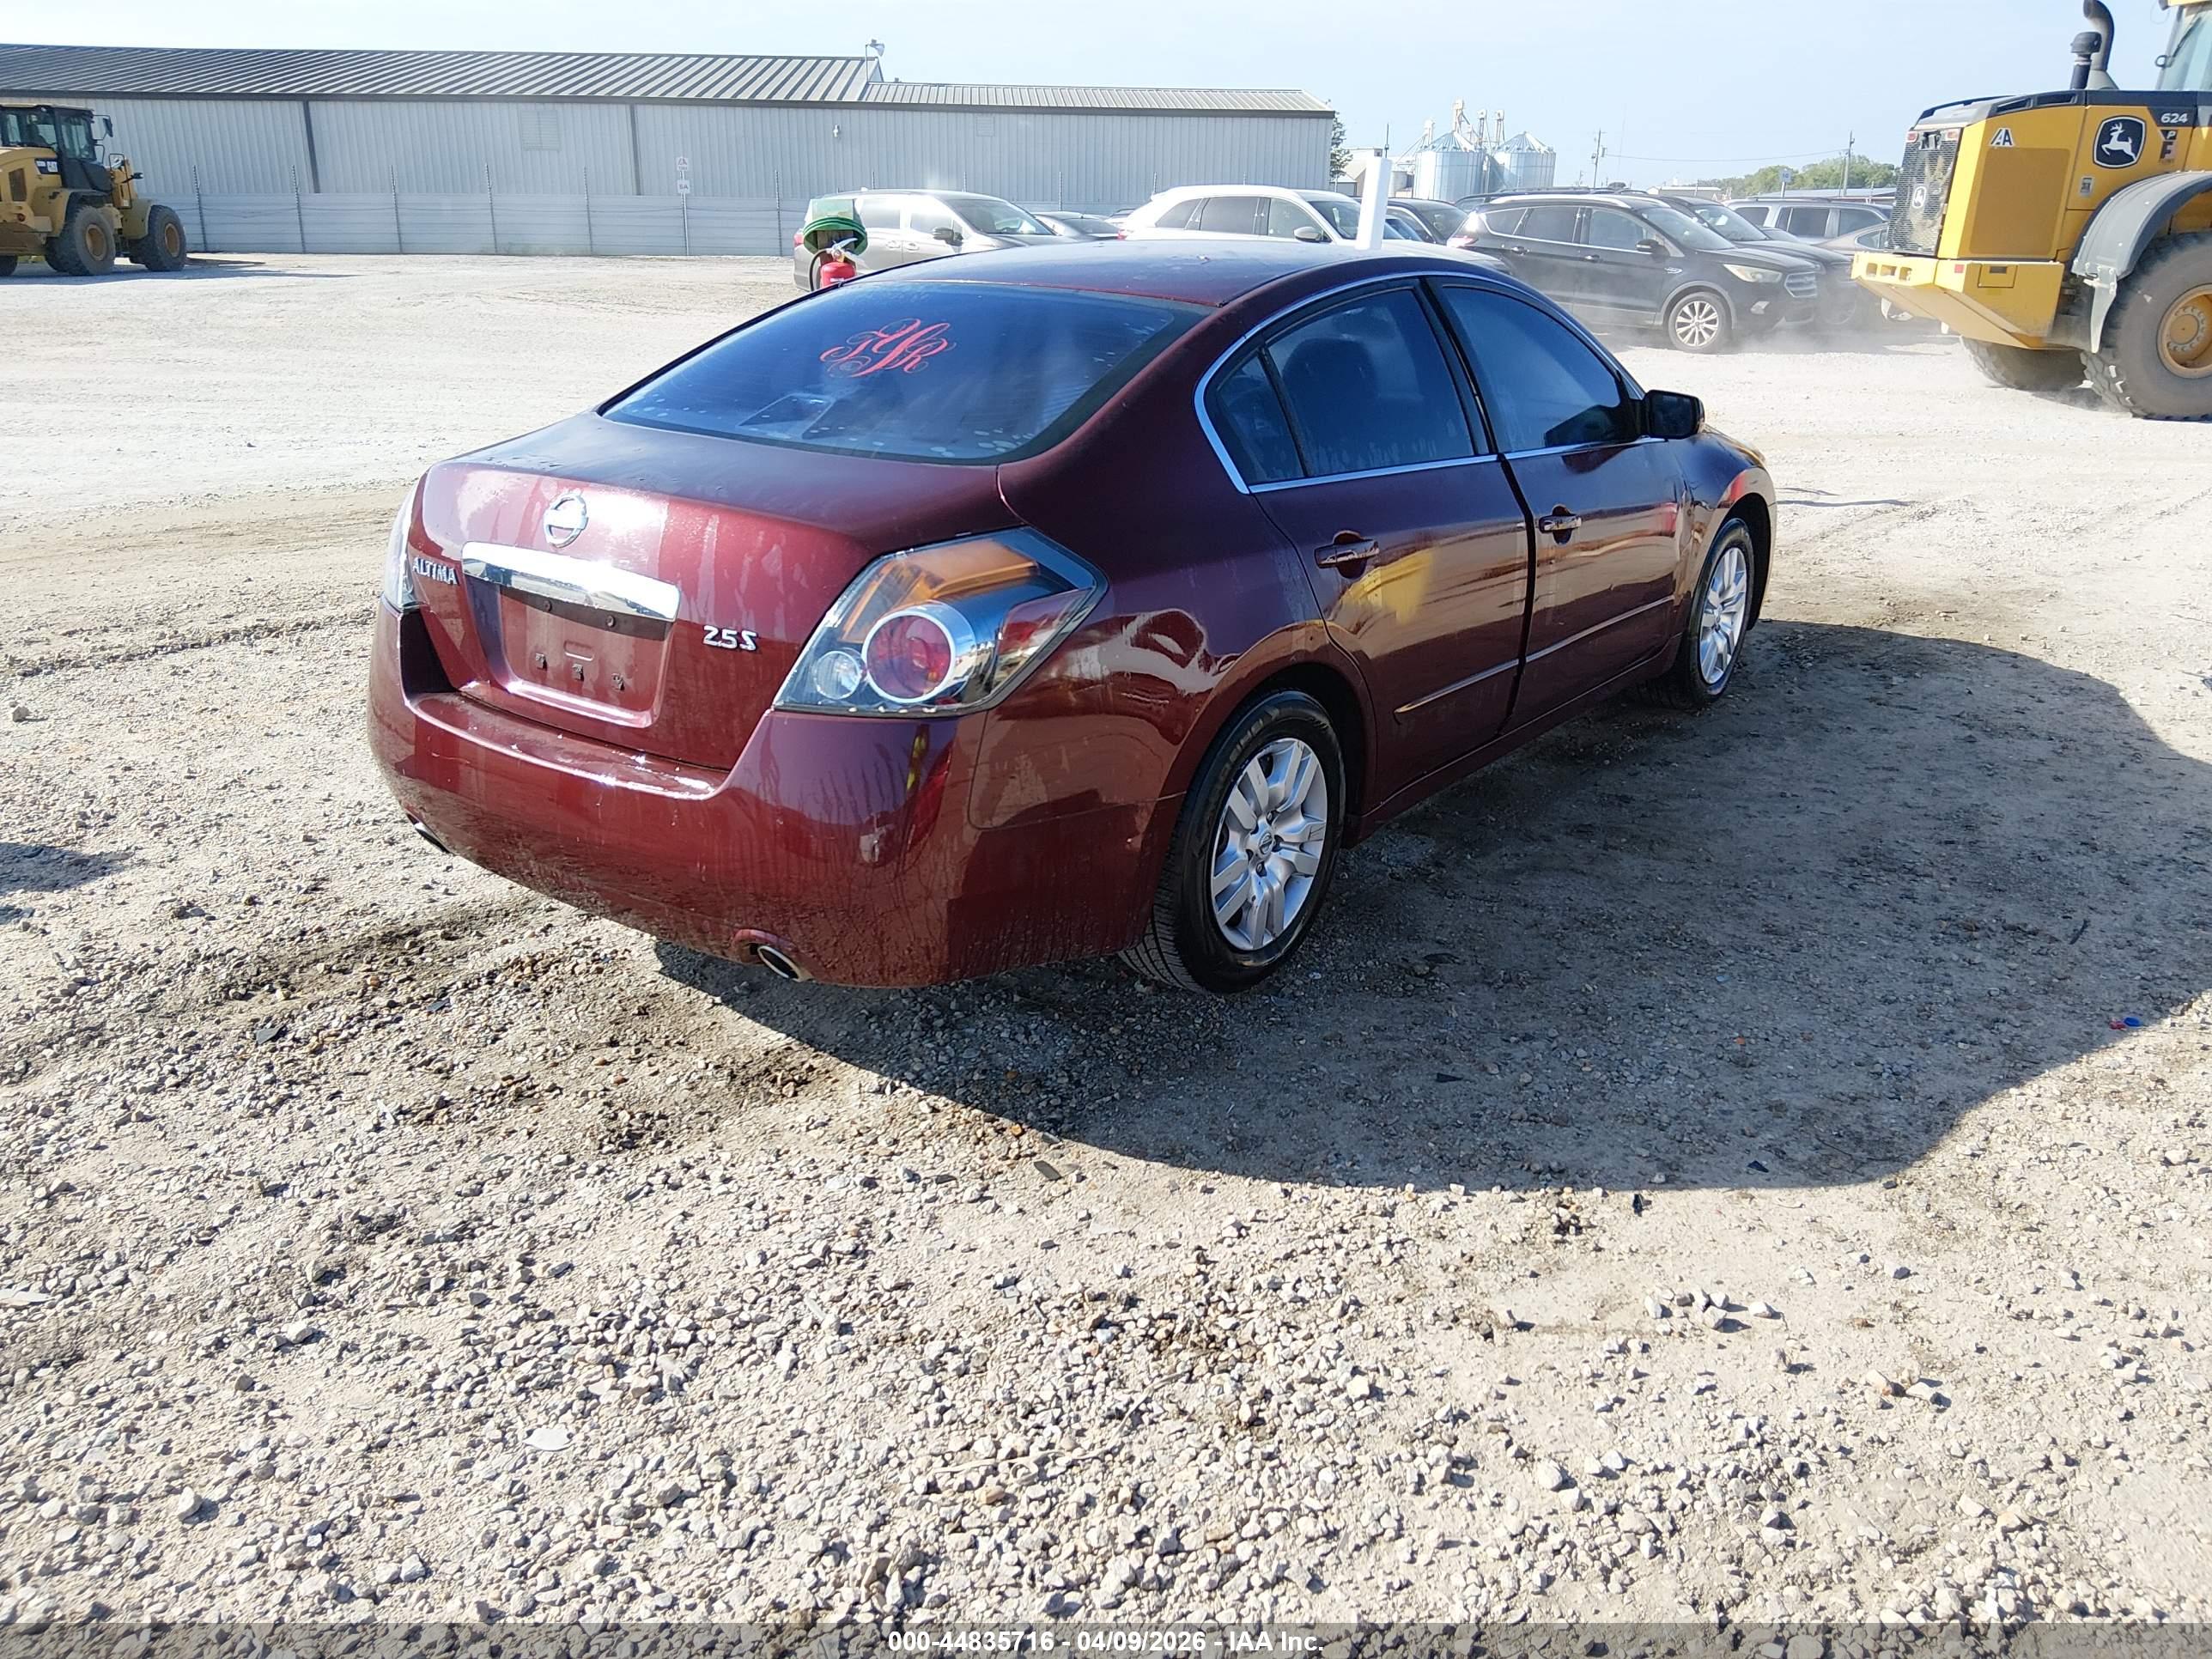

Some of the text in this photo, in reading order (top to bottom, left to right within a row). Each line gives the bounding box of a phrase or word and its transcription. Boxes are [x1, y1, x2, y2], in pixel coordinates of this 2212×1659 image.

[2160, 112, 2188, 124] 624
[2166, 131, 2177, 139] P
[412, 556, 459, 585] ALTIMA
